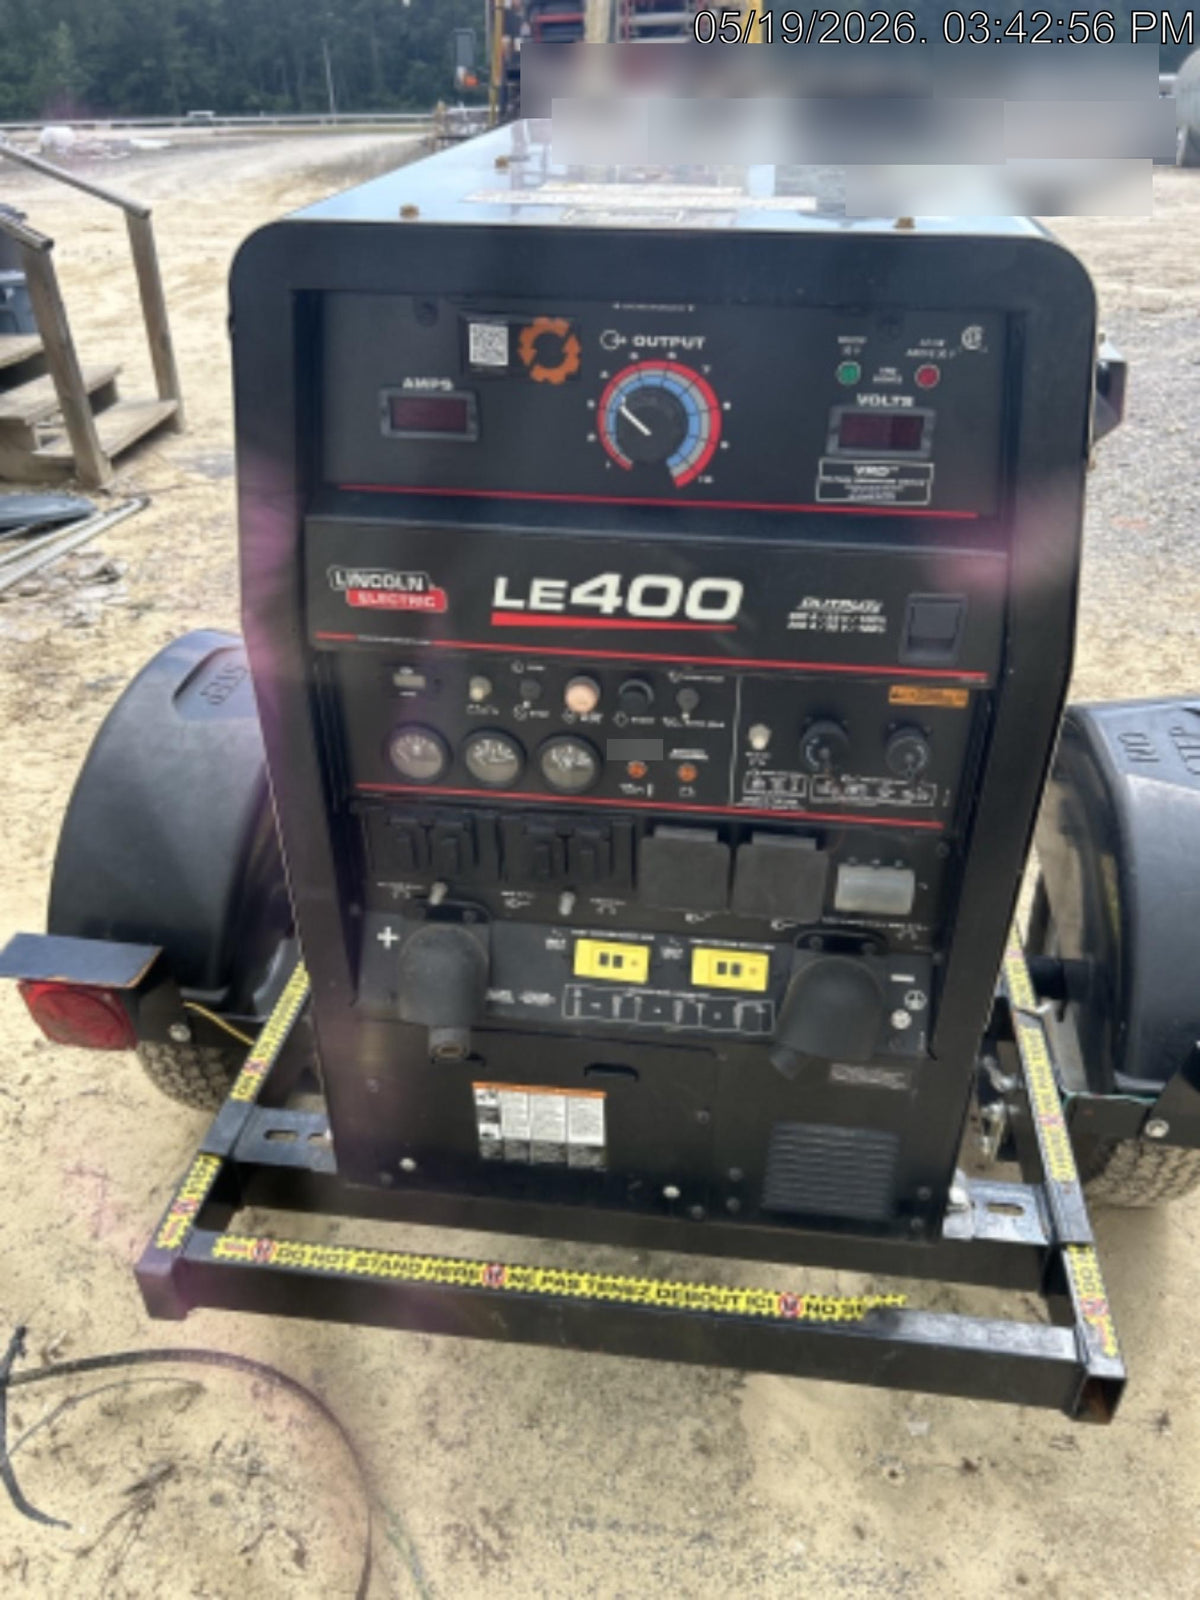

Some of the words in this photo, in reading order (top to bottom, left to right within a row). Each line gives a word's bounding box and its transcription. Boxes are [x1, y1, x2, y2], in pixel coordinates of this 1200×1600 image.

[631, 335, 706, 349] OUTPUT
[402, 375, 454, 391] AMPS
[856, 392, 914, 408] VOLTS
[333, 569, 425, 591] LINCOLN
[357, 590, 437, 609] ELECTRIC
[491, 572, 745, 622] LE400
[276, 1246, 303, 1260] DO
[312, 1251, 352, 1266] NOT
[355, 1255, 422, 1274] STAND
[541, 1273, 581, 1290] PAS
[586, 1279, 651, 1297] TENEZ
[656, 1286, 739, 1307] DEBOUT
[746, 1296, 773, 1309] ICI
[805, 1301, 837, 1316] NO
